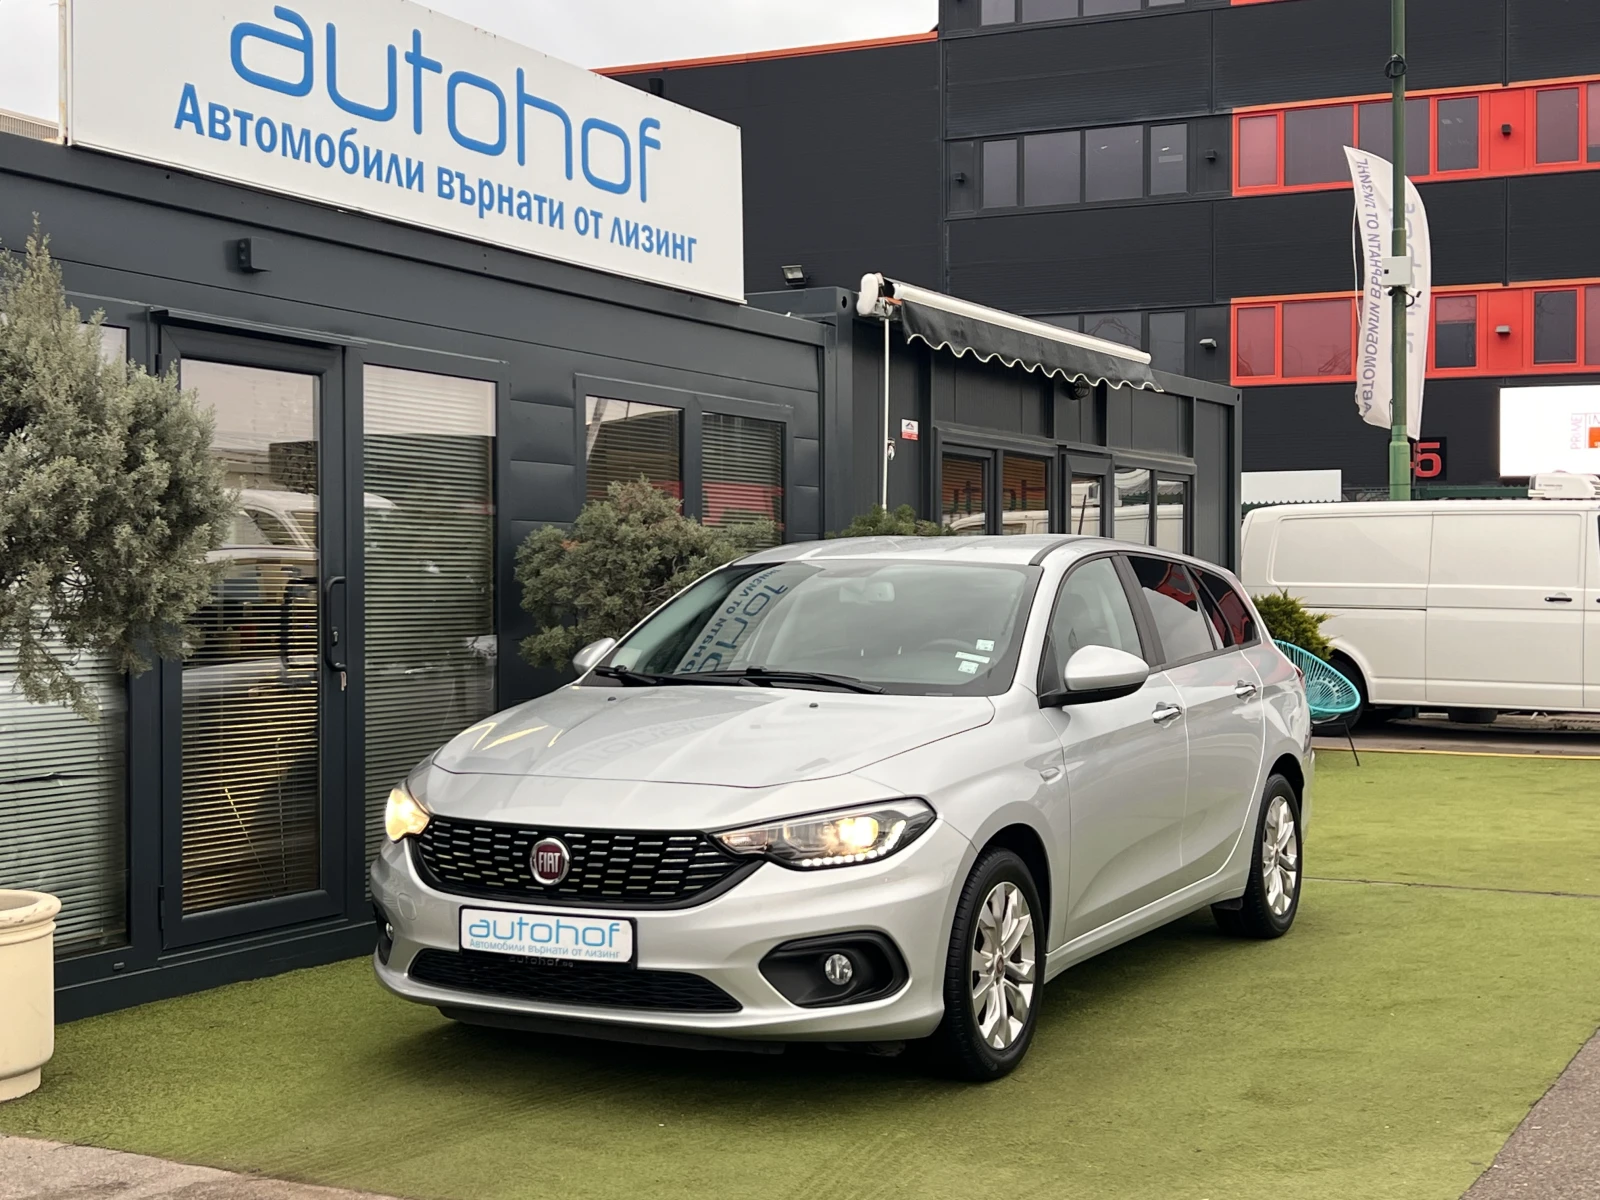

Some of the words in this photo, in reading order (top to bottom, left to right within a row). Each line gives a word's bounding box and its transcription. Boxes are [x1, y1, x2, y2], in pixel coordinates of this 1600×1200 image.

[230, 5, 661, 203] autohof
[174, 83, 425, 193] Автомобили
[437, 166, 565, 230] върнати
[574, 206, 603, 239] от
[610, 216, 697, 263] лизинг
[538, 851, 561, 873] FIAT
[468, 916, 620, 948] autohof
[469, 939, 525, 952] Автомобили
[528, 944, 569, 955] върнати
[571, 948, 583, 957] от
[585, 949, 620, 959] лизинг
